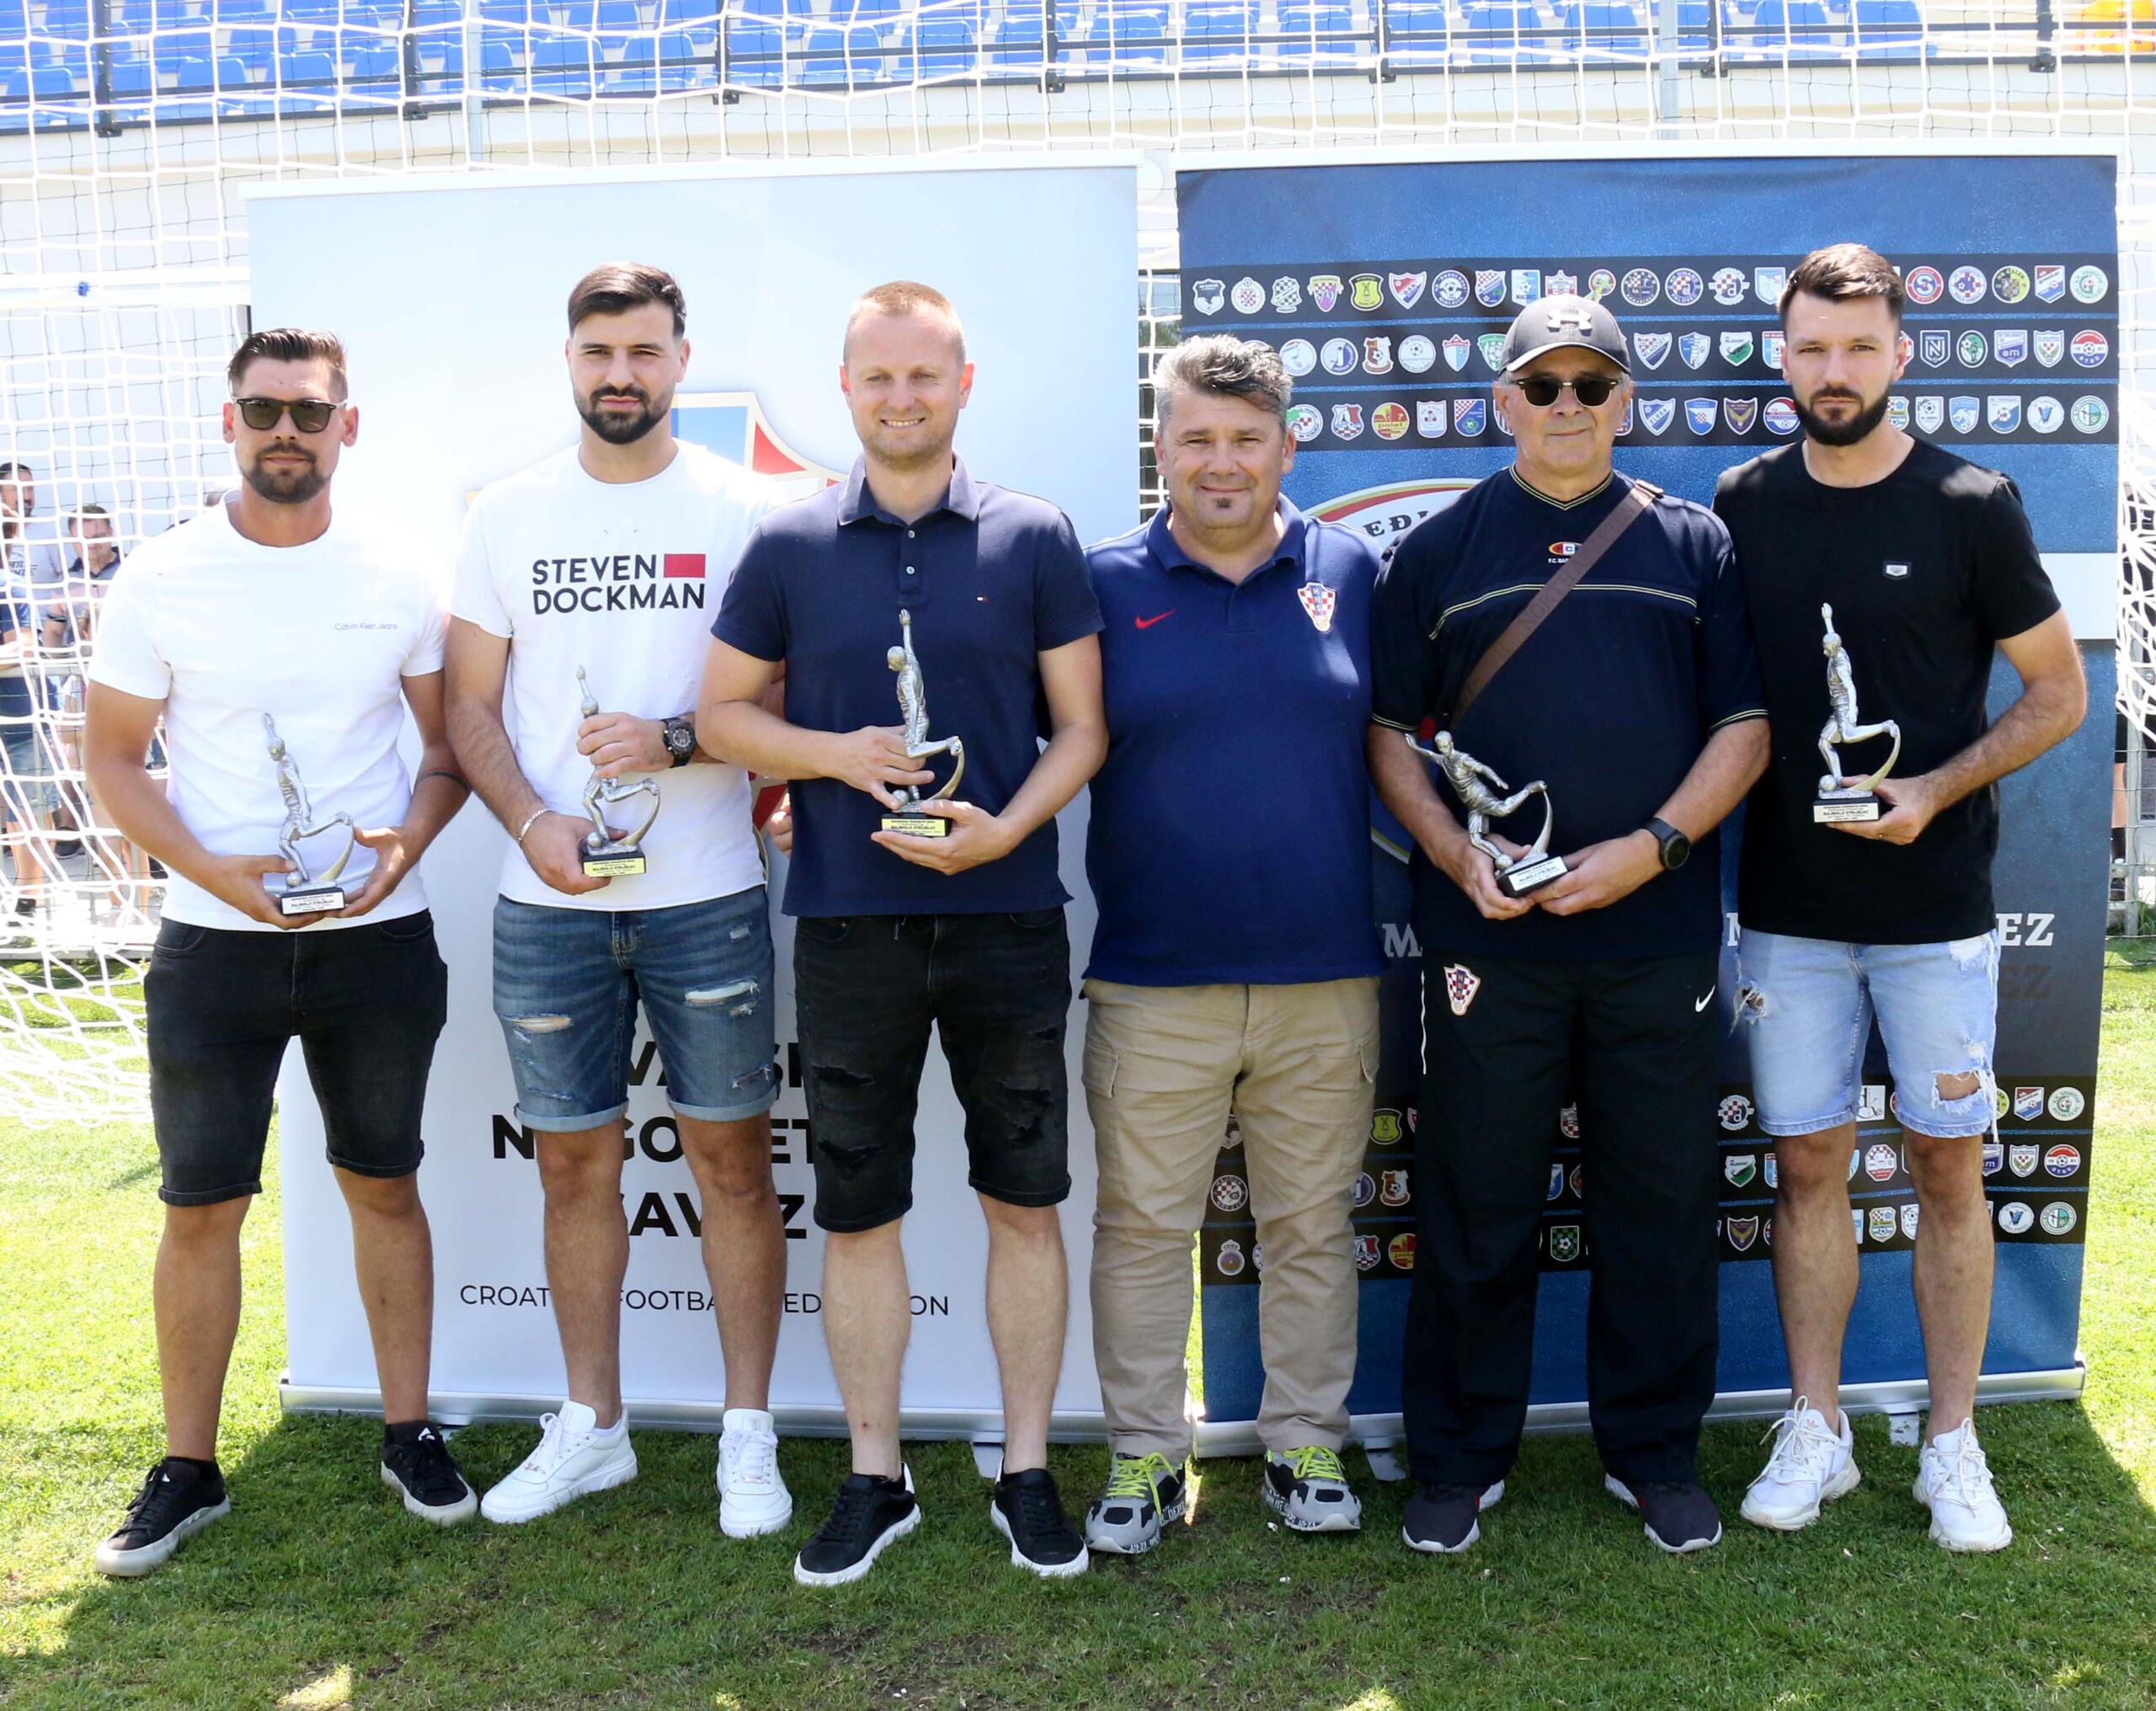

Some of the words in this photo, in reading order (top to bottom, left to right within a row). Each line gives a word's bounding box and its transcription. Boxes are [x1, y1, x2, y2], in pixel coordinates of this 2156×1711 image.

[532, 554, 657, 584] STEVEN
[533, 583, 705, 615] DOCKMAN
[460, 1285, 550, 1307] CROAT
